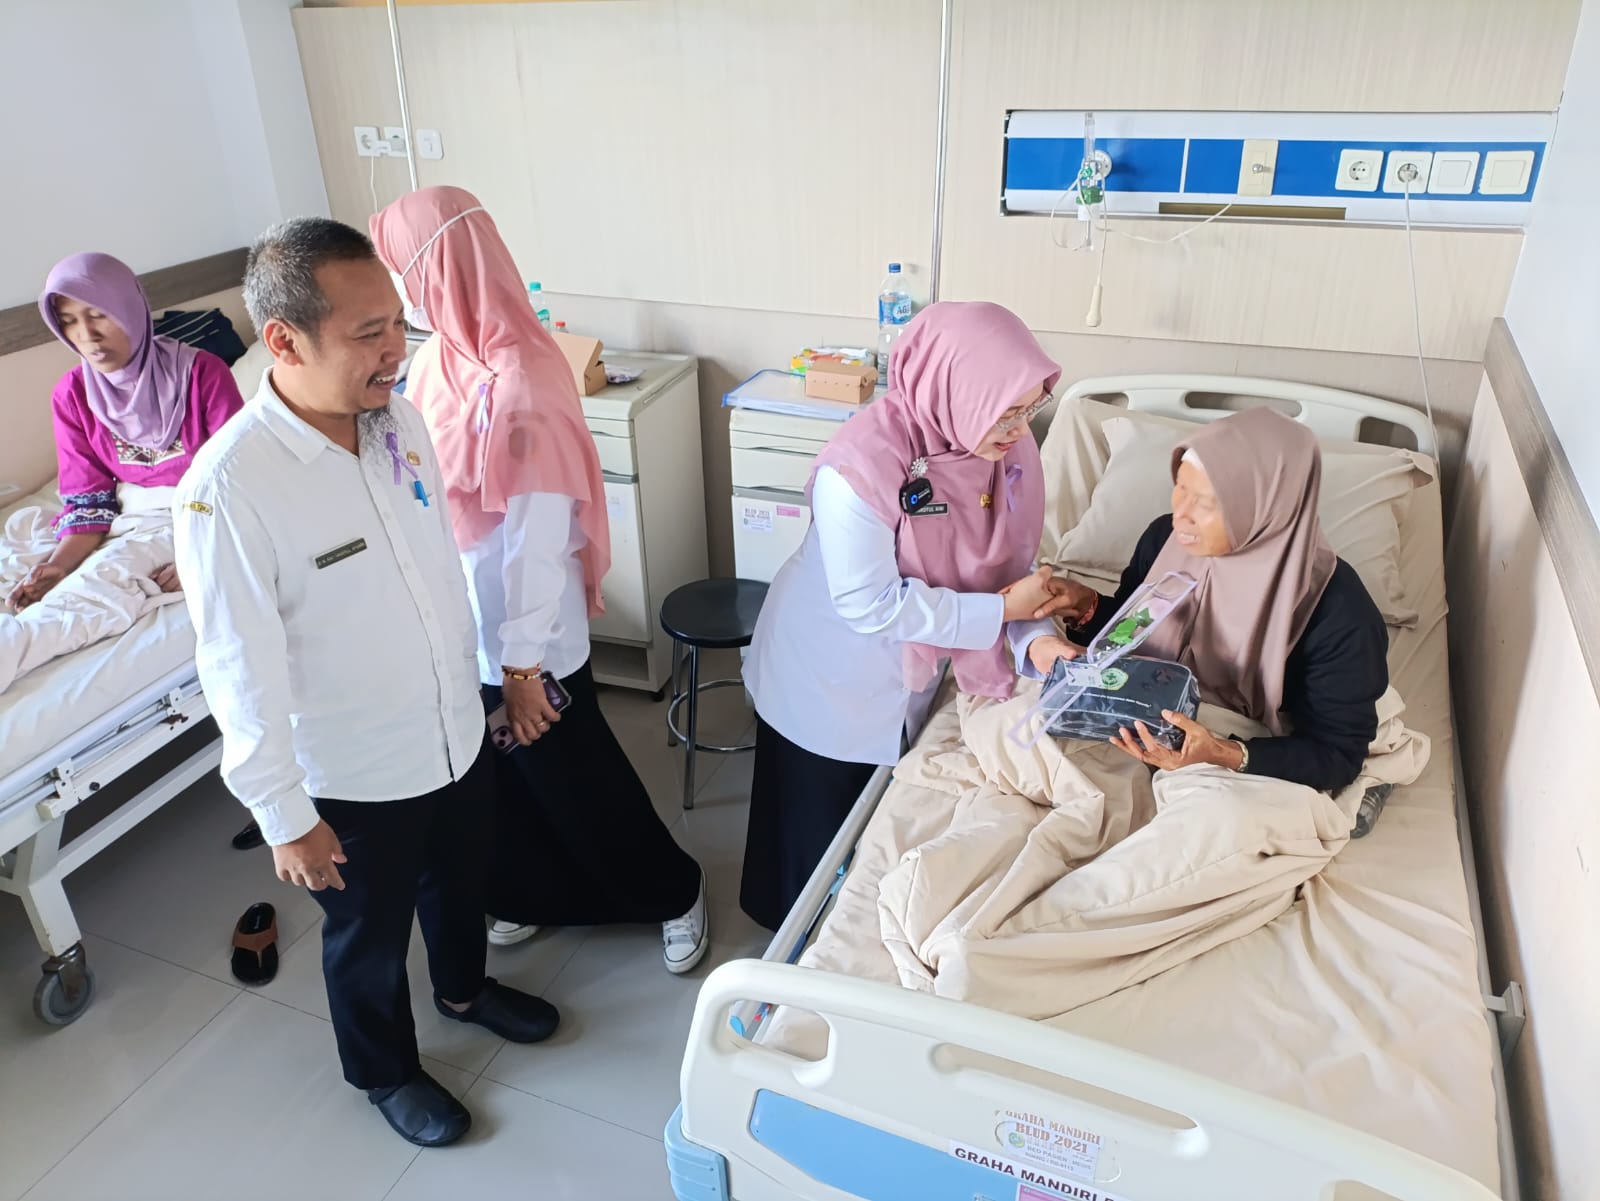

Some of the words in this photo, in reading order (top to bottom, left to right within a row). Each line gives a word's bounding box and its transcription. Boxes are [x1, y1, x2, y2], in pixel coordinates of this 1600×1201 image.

[1015, 1122, 1050, 1141] BLUD
[1054, 1134, 1088, 1153] 2021
[1049, 1120, 1101, 1145] MANDIRI
[954, 1147, 1015, 1176] GRAHA
[1020, 1168, 1098, 1201] MANDIRI
